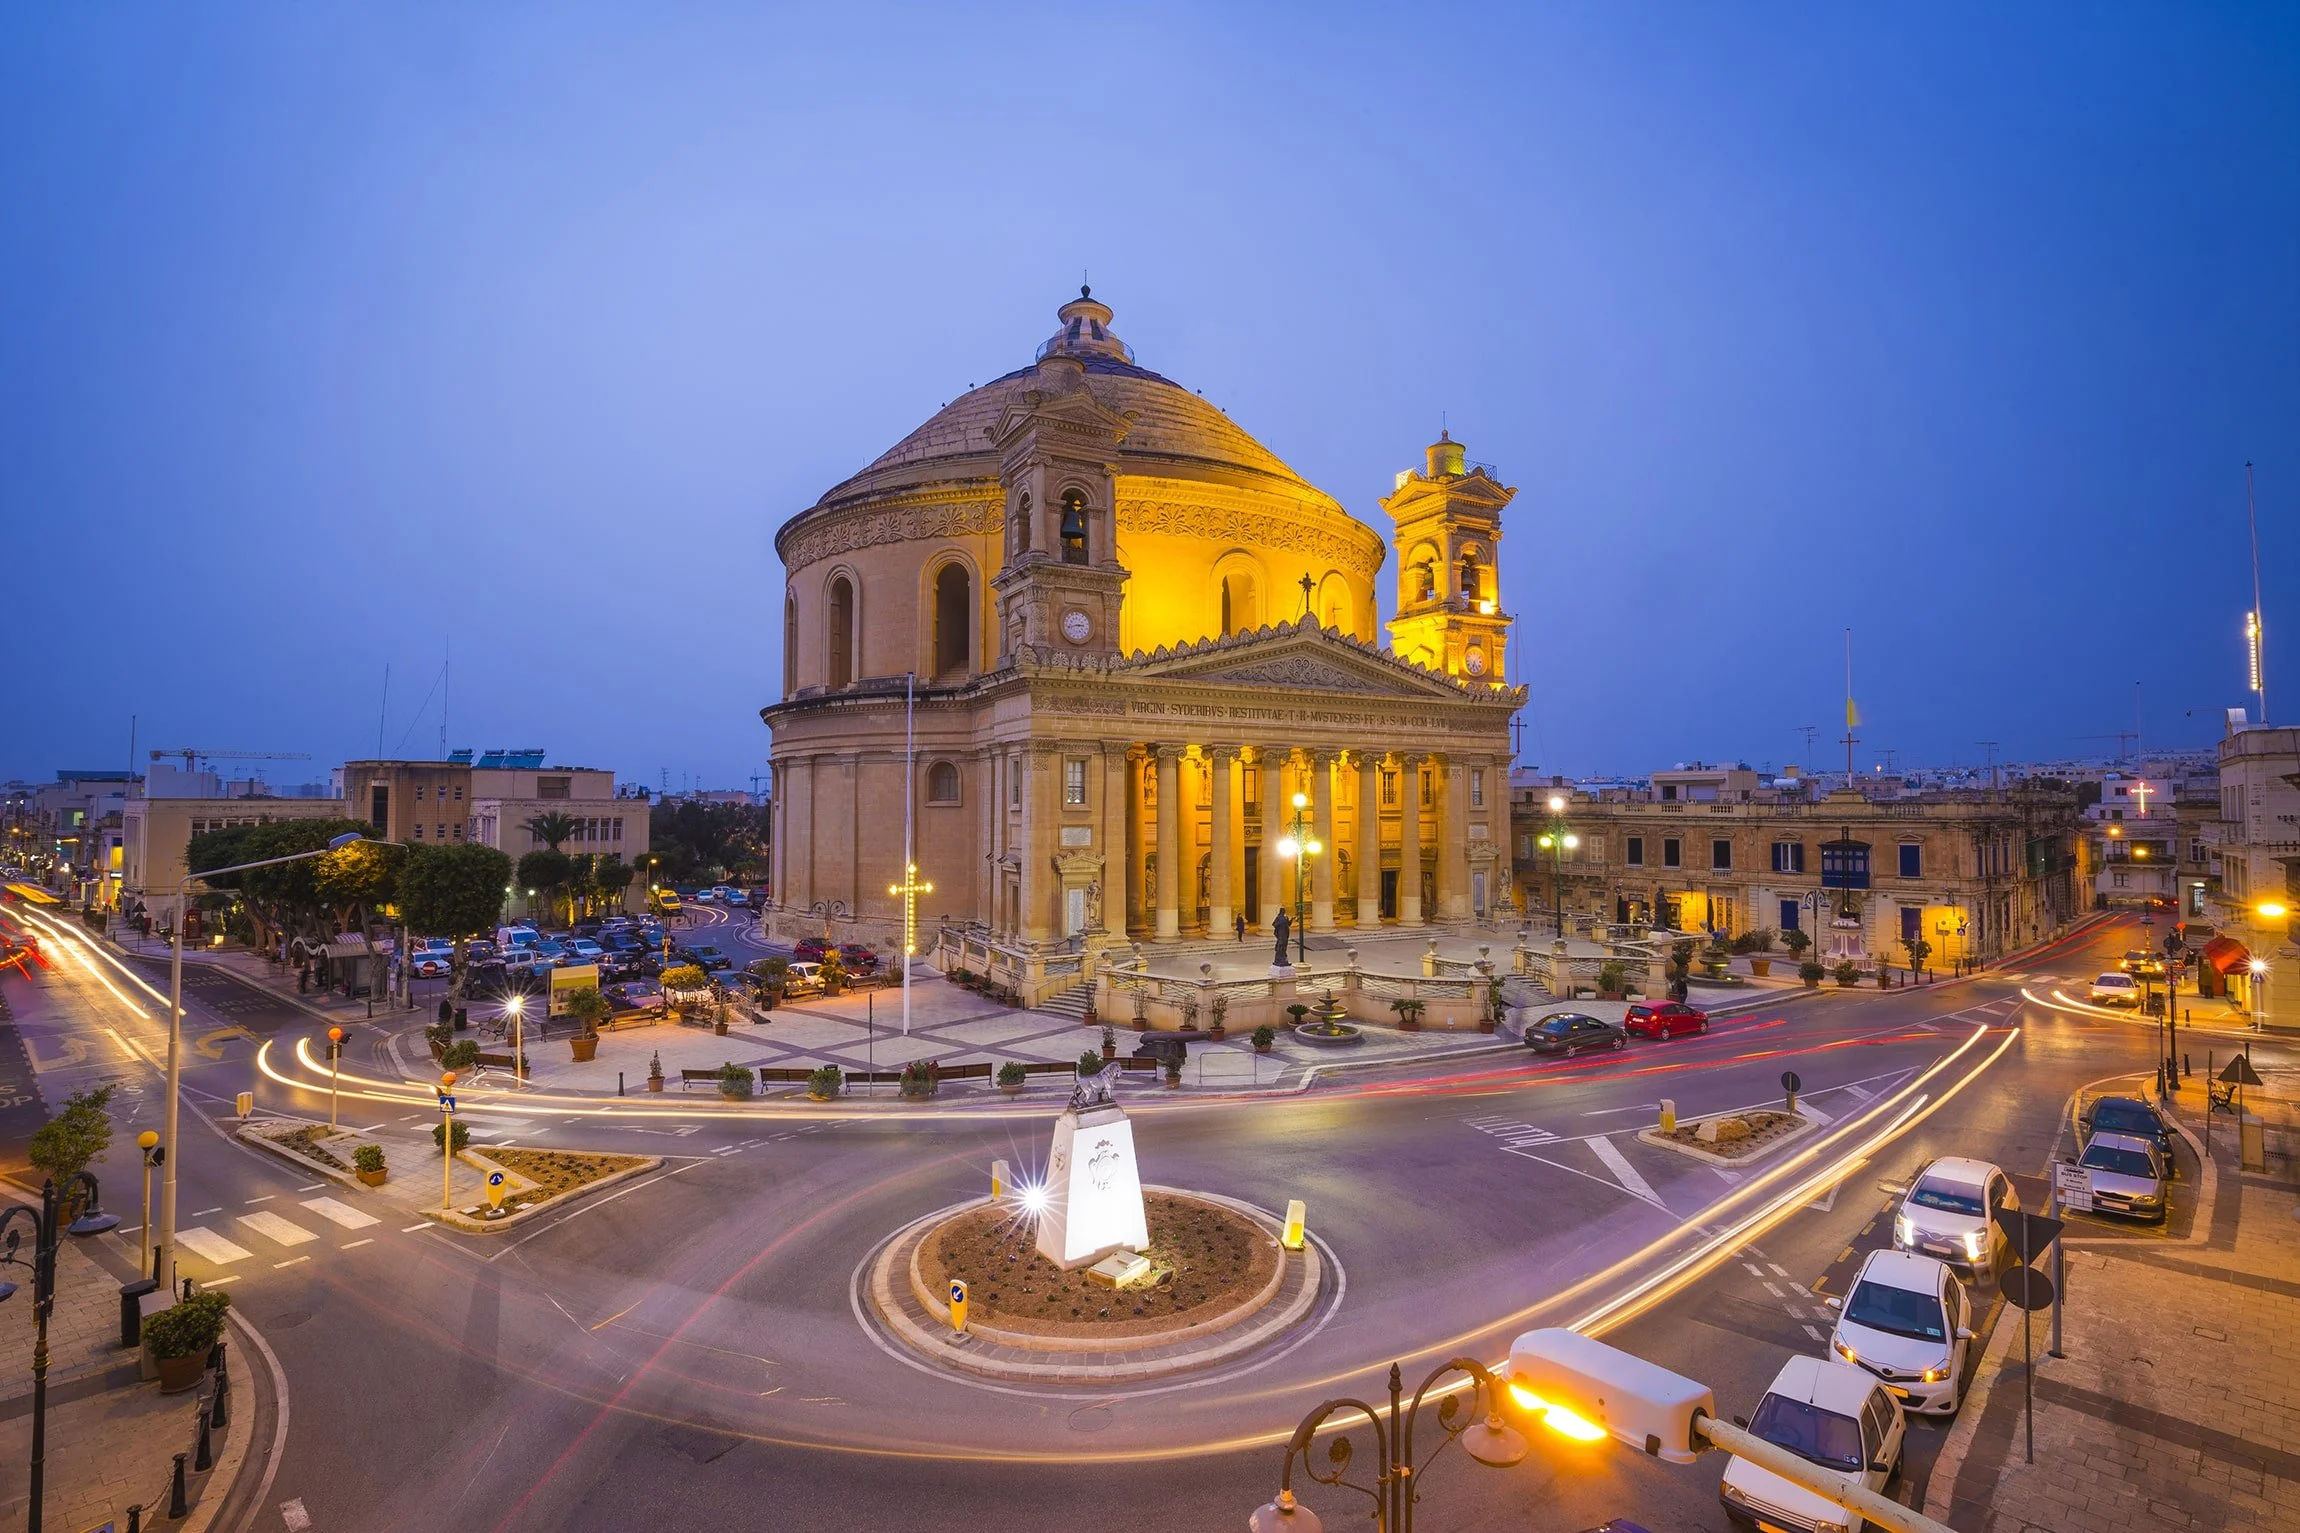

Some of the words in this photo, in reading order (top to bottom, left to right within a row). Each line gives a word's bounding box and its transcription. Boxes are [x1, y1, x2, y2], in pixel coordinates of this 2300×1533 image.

[1131, 701, 1165, 714] VIRGINI
[1171, 703, 1224, 718] SYDERIBVS
[1229, 706, 1285, 721] RESTITVTAE
[1310, 711, 1361, 725] MVSTENSES
